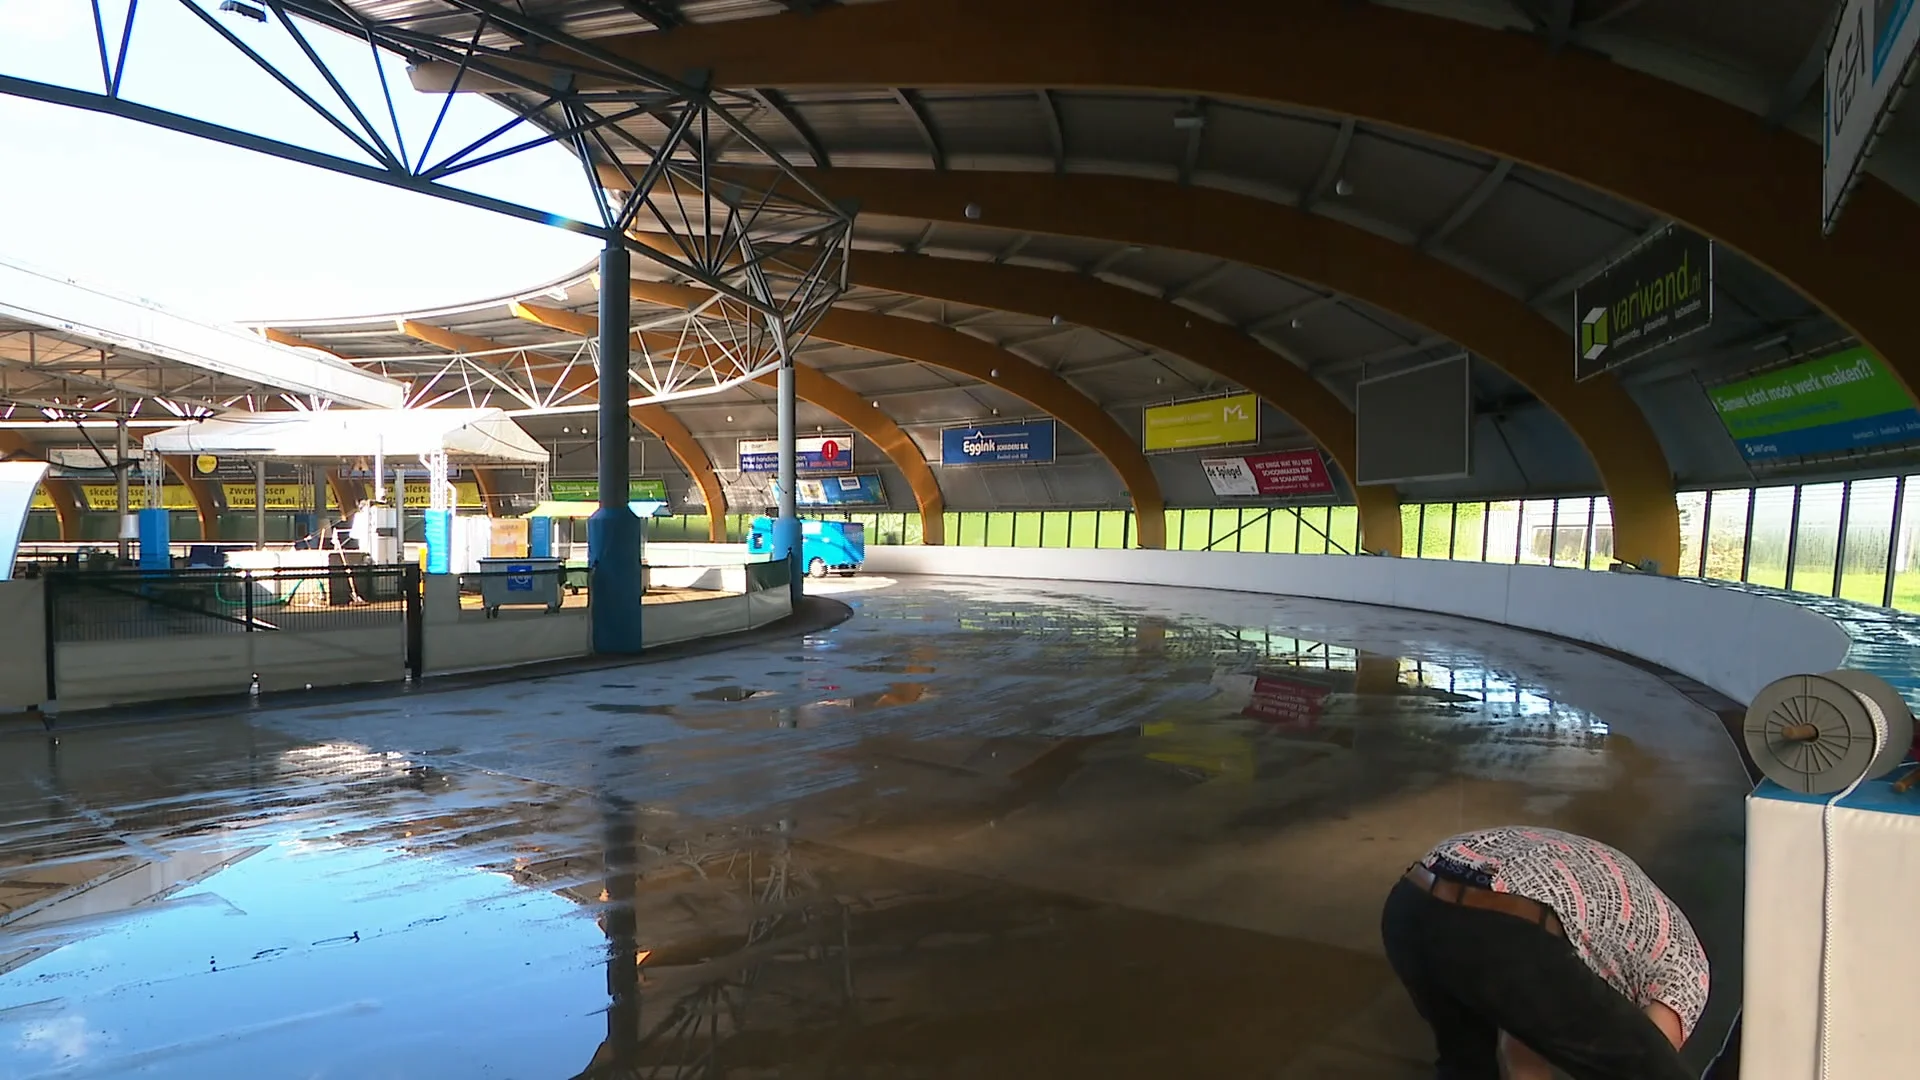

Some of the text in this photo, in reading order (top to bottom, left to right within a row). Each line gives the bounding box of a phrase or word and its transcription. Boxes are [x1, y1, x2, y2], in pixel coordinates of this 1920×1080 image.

[1612, 248, 1701, 332] variwand.nl
[1767, 380, 1793, 401] mooi
[1792, 373, 1823, 397] werk
[1822, 359, 1875, 389] maken?!
[963, 439, 995, 456] Eggink
[1207, 465, 1242, 479] de Spiegel
[229, 487, 285, 495] zwemssen
[233, 497, 295, 505] krasort.nl
